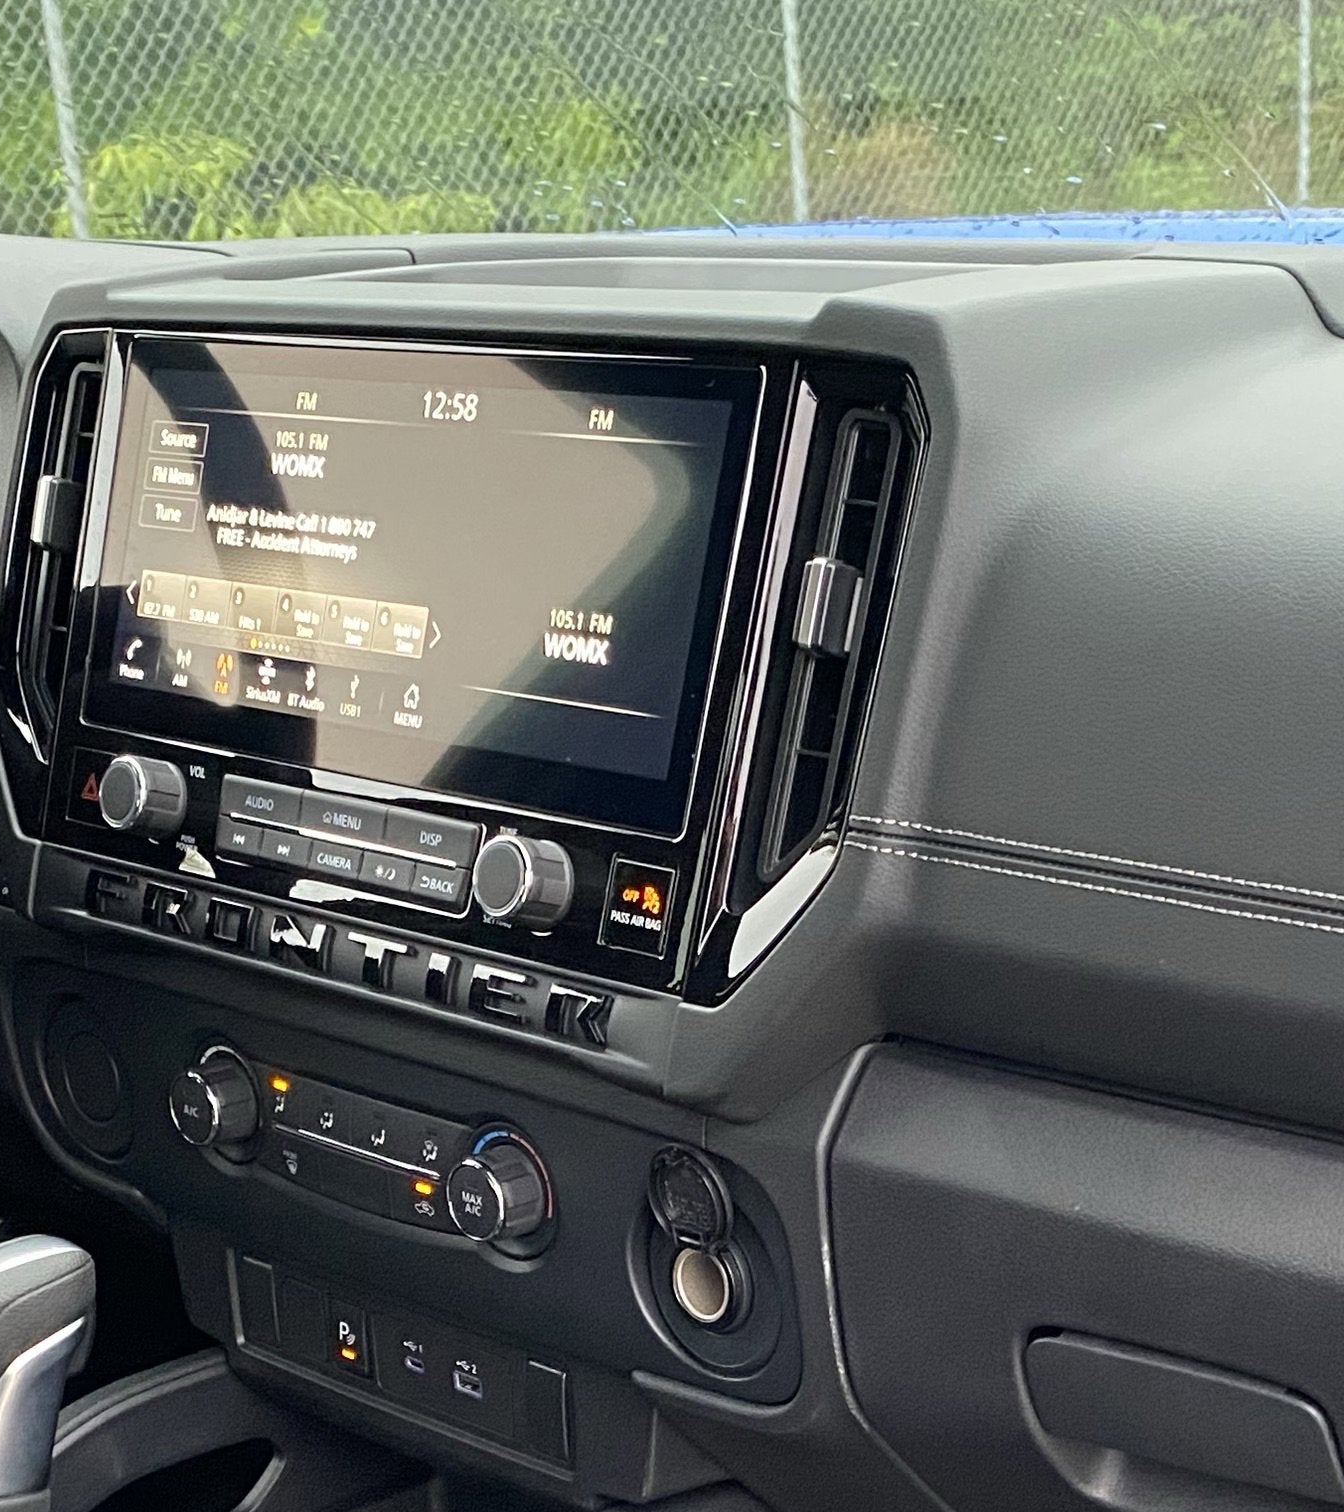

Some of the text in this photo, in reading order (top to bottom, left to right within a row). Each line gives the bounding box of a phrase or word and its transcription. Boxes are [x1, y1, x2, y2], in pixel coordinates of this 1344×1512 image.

[296, 392, 318, 410] FM
[423, 391, 479, 421] 12:58
[588, 409, 614, 431] FM
[160, 429, 197, 449] Source
[276, 430, 328, 451] 105.1 FM
[152, 465, 168, 482] FM
[271, 452, 326, 478] WOMX
[155, 503, 182, 522] Tune
[206, 504, 249, 527] Anidjar
[296, 513, 320, 532] Call
[352, 518, 376, 539] 747
[217, 527, 245, 547] FREE
[251, 531, 300, 553] Accident
[300, 536, 358, 564] Attorneys
[204, 610, 220, 625] AM
[550, 609, 613, 635] 105.1 FM
[544, 632, 611, 666] WOMX
[119, 663, 144, 680] Phone
[172, 673, 188, 688] AM
[214, 680, 228, 694] FM
[245, 685, 281, 704] SiriusXM
[299, 695, 325, 712] Audio
[340, 704, 361, 718] USB1
[393, 711, 423, 729] MENU
[189, 765, 206, 779] VOL
[245, 794, 274, 812] AUDIO
[332, 812, 362, 831] MENU
[419, 830, 443, 847] DISP
[316, 852, 352, 870] CAMERA
[429, 876, 455, 894] BACK
[622, 888, 640, 903] OFF
[610, 909, 662, 932] PASS AIR BAG
[87, 867, 616, 1049] FRONTIER
[183, 1104, 199, 1118] A/C
[461, 1191, 483, 1207] MAX
[464, 1202, 482, 1217] A/C
[339, 1321, 350, 1341] P
